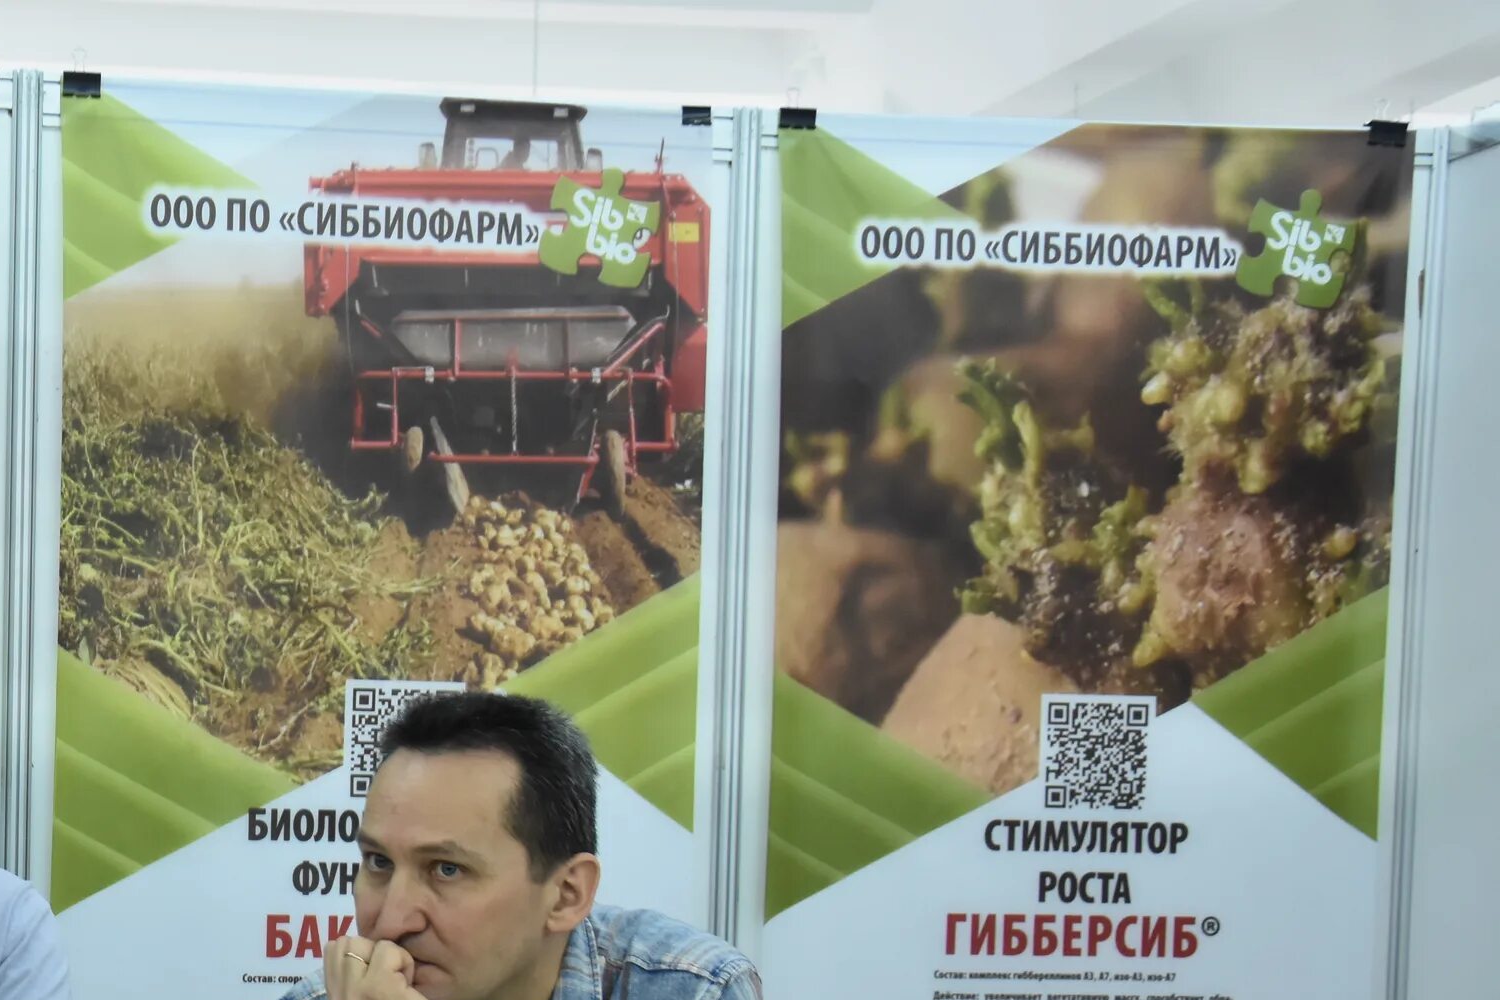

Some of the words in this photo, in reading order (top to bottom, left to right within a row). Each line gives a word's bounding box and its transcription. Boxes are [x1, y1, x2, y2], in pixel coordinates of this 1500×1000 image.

[150, 193, 217, 230] ООО
[227, 198, 271, 233] ПО
[279, 202, 539, 246] «СИББИОФАРМ»
[571, 189, 624, 229] Sib
[586, 225, 636, 264] bio
[860, 225, 924, 260] ООО
[934, 228, 976, 262] ПО
[985, 230, 1237, 270] «СИББИОФАРМ»
[1267, 211, 1320, 251] Sib
[1283, 245, 1332, 286] bio
[984, 819, 1189, 854] СТИМУЛЯТОР
[1038, 872, 1132, 904] РОСТА
